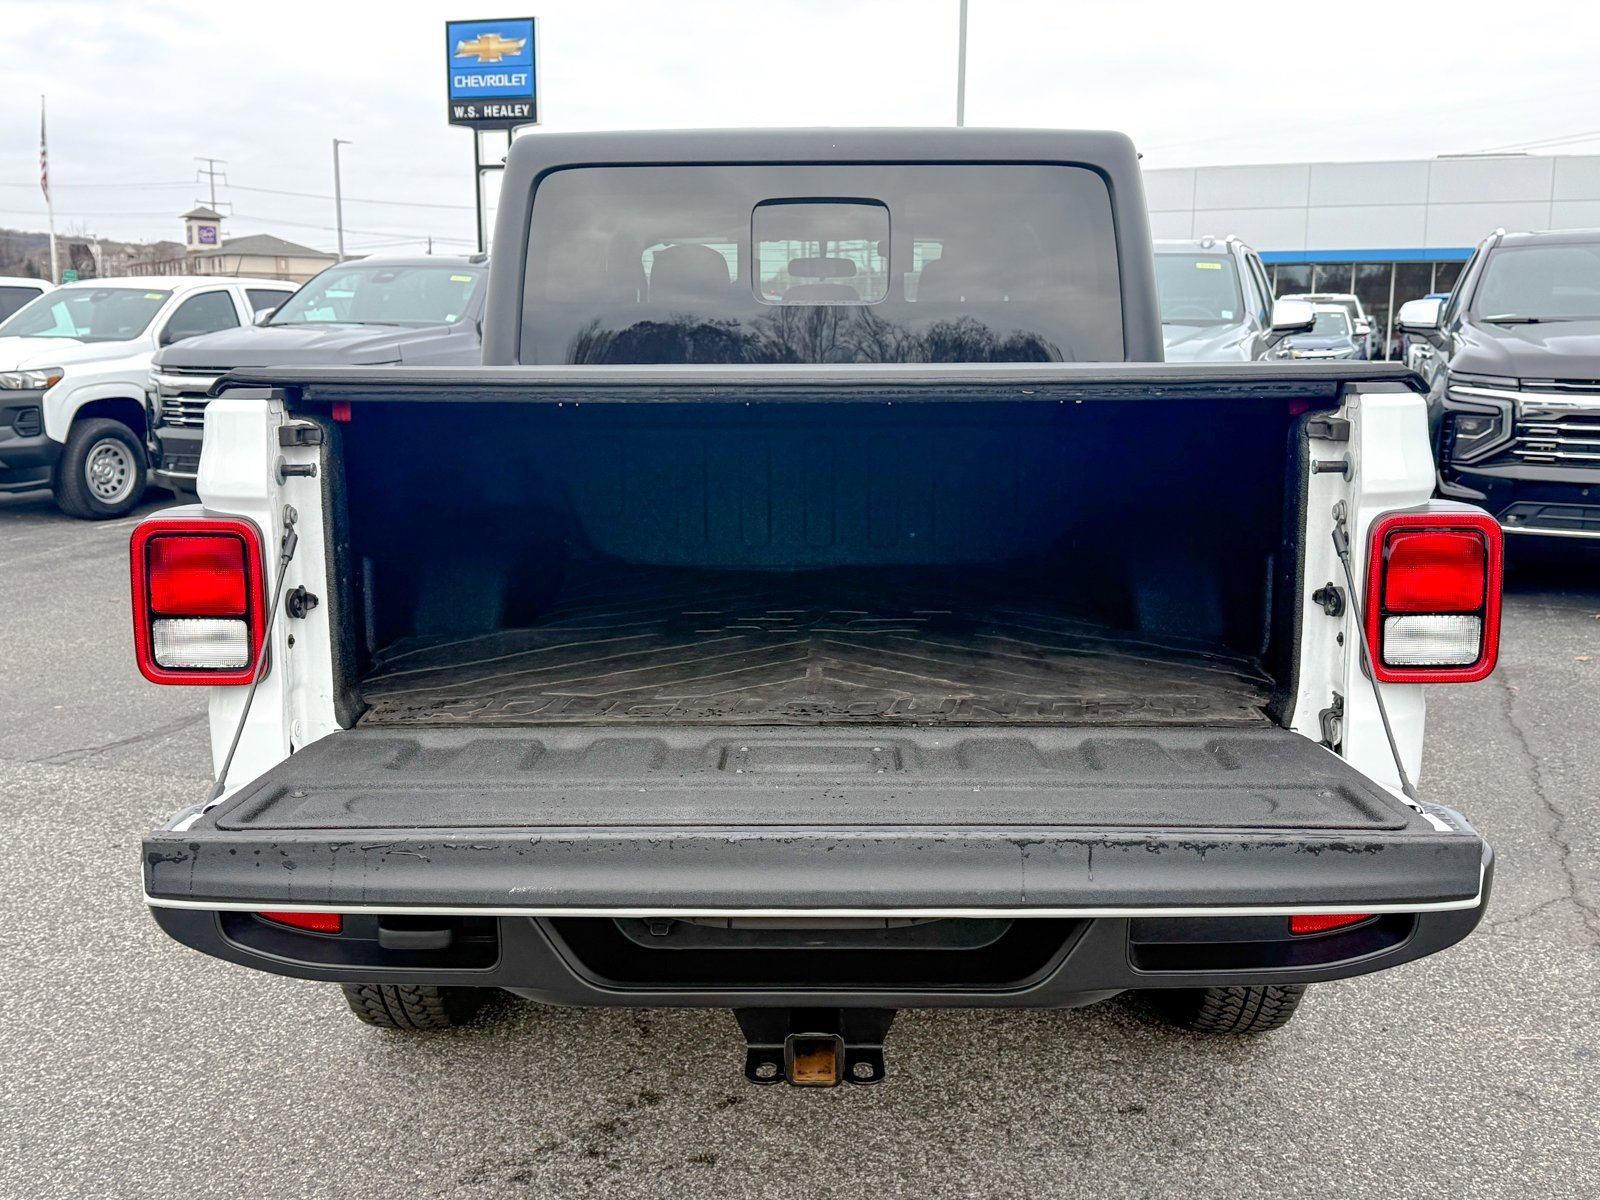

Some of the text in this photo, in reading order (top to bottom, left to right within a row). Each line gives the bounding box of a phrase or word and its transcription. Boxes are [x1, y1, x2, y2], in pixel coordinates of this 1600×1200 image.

[454, 74, 528, 88] CHEVROLET
[454, 104, 530, 118] W.S. HEALEY
